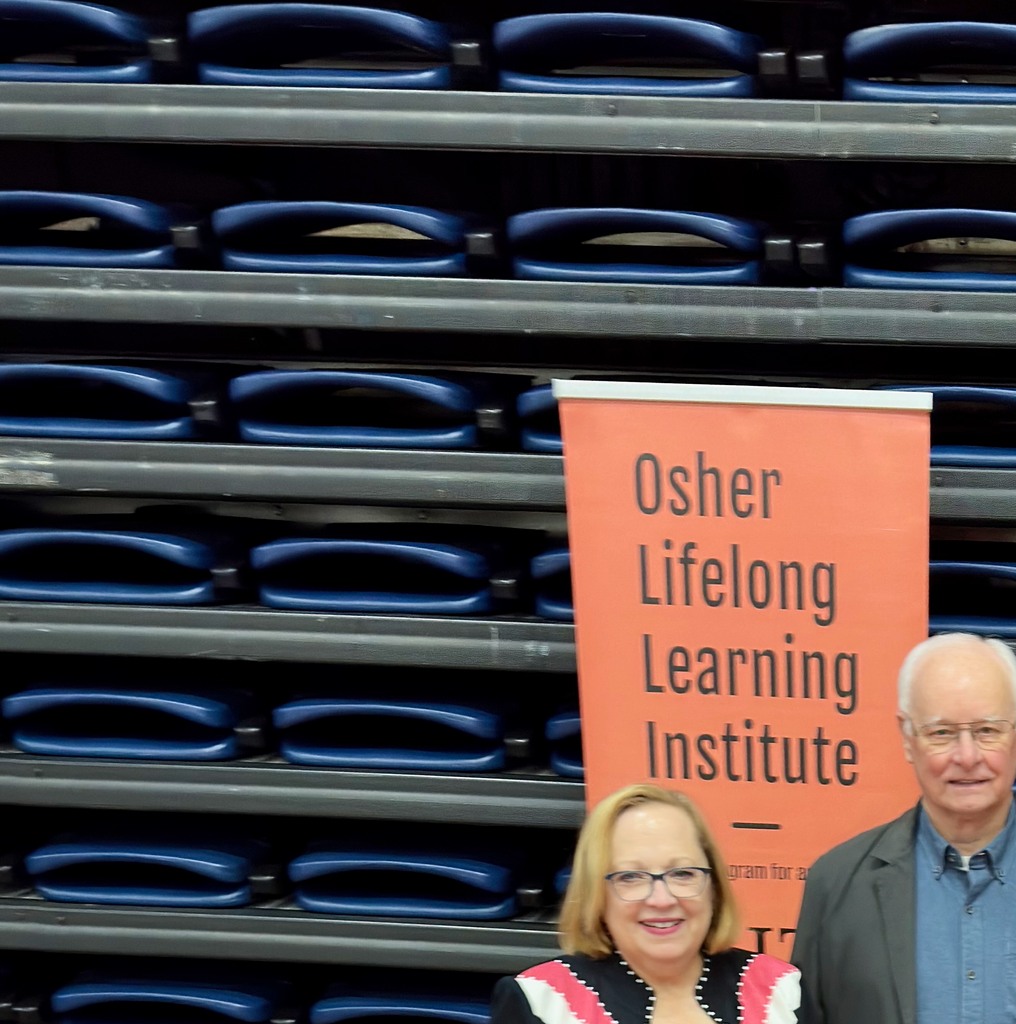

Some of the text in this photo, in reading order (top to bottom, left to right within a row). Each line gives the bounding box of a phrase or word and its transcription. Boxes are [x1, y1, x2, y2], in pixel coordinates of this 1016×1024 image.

[635, 451, 782, 519] Osher
[639, 540, 836, 626] Lifelong
[642, 633, 859, 715] Learning
[647, 719, 859, 786] Institute
[728, 864, 768, 881] gram
[770, 863, 793, 881] for
